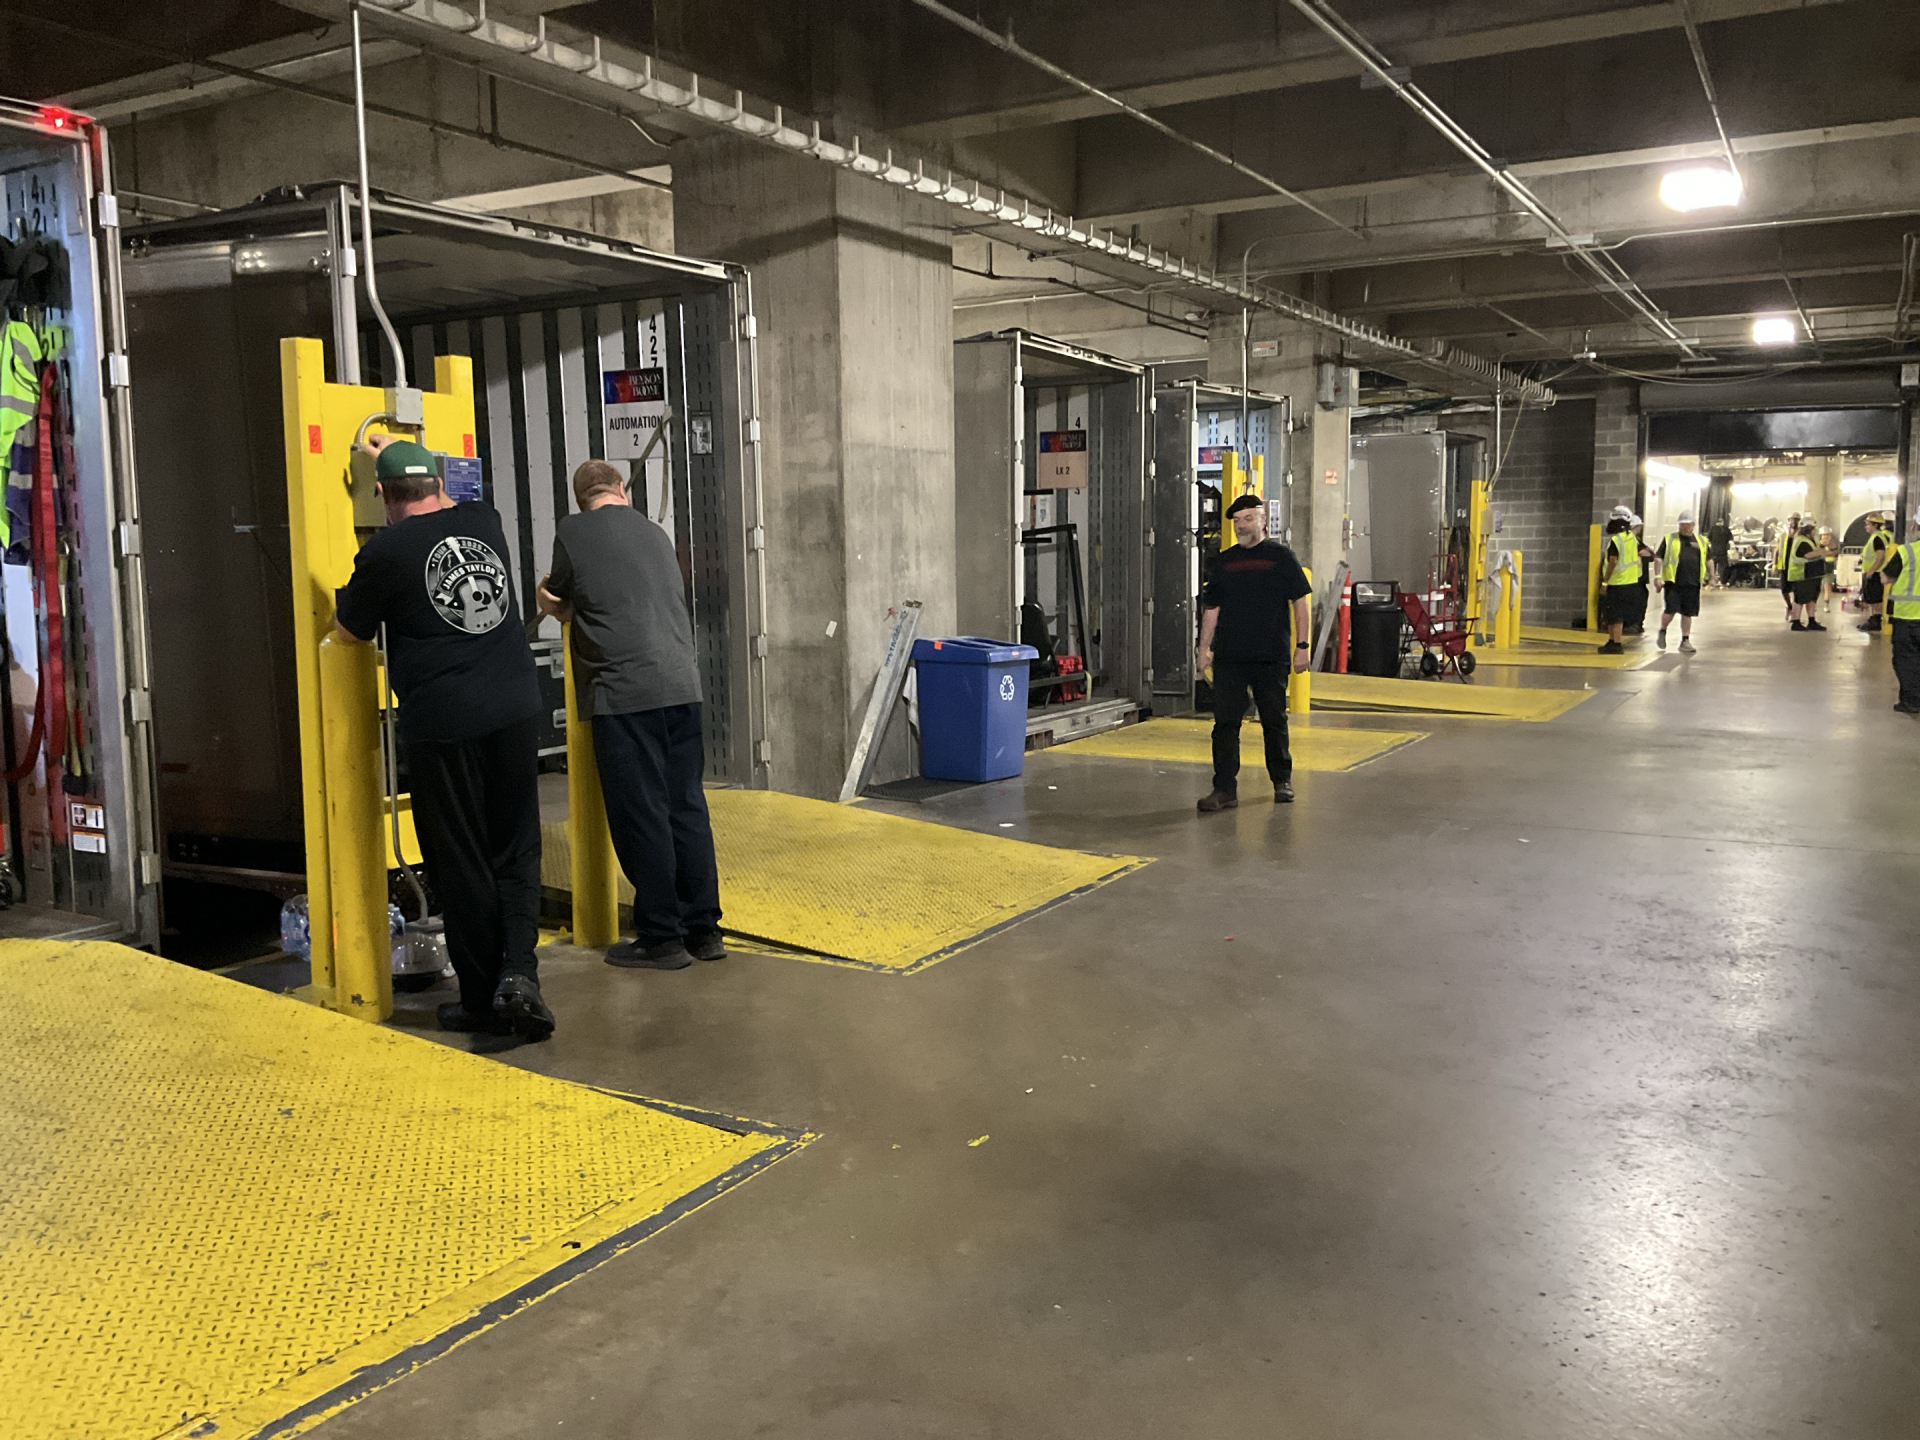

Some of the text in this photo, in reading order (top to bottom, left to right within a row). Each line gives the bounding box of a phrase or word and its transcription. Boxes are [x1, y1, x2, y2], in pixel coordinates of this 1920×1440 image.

[609, 415, 663, 431] AUTOMATION
[633, 434, 639, 446] 2
[1056, 466, 1070, 475] LX 2
[432, 545, 447, 562] TOUR
[443, 564, 496, 590] JAMES TAYLOR
